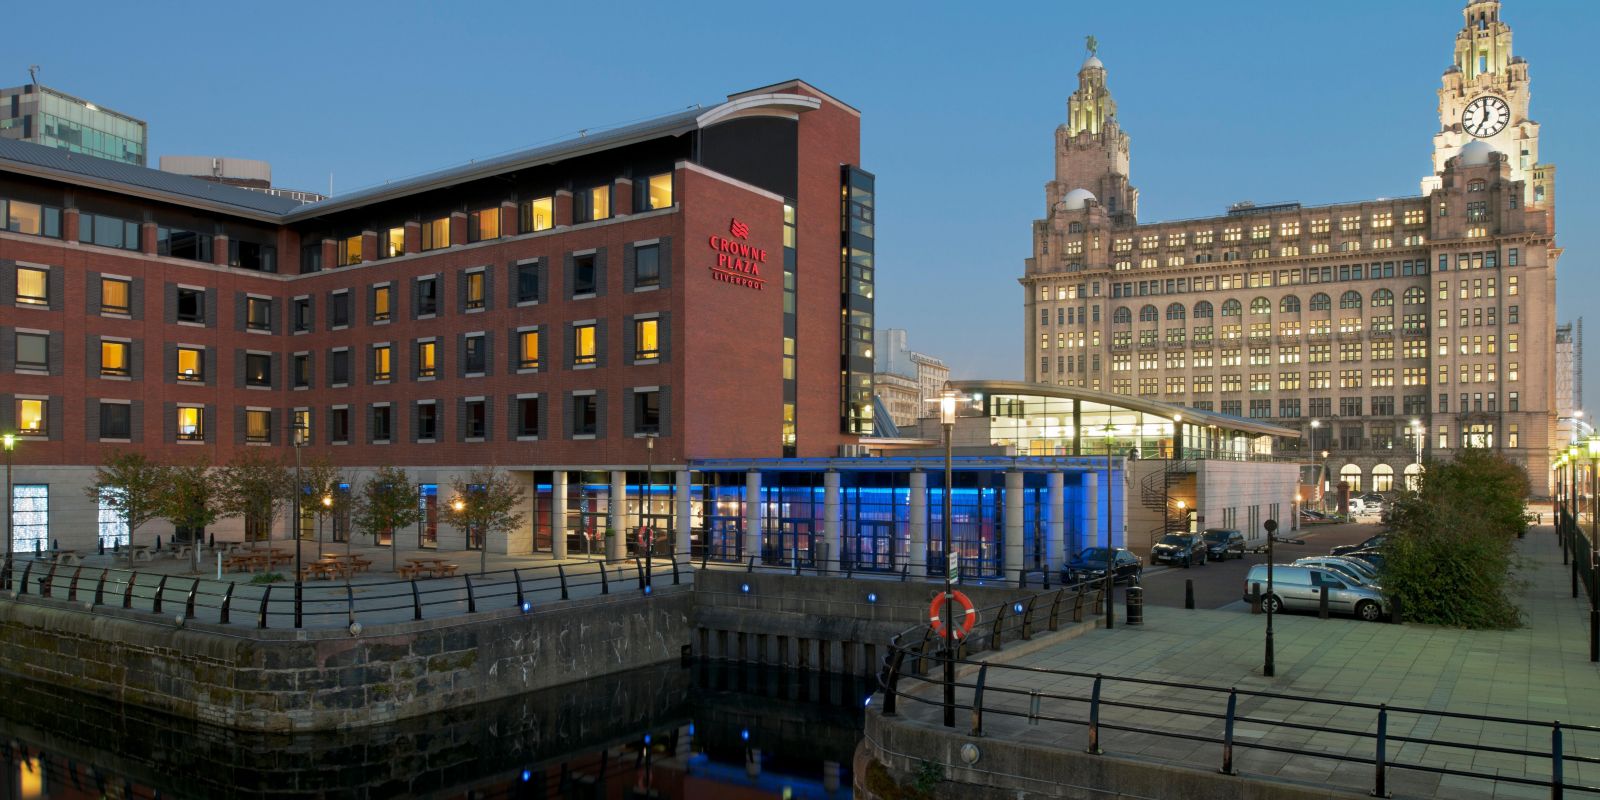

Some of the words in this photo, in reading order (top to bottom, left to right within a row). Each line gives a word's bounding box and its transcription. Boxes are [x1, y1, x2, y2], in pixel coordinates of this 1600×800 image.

[709, 235, 767, 263] CROWNE
[718, 253, 759, 275] PLAZA
[713, 271, 764, 290] LIVERPOOL
